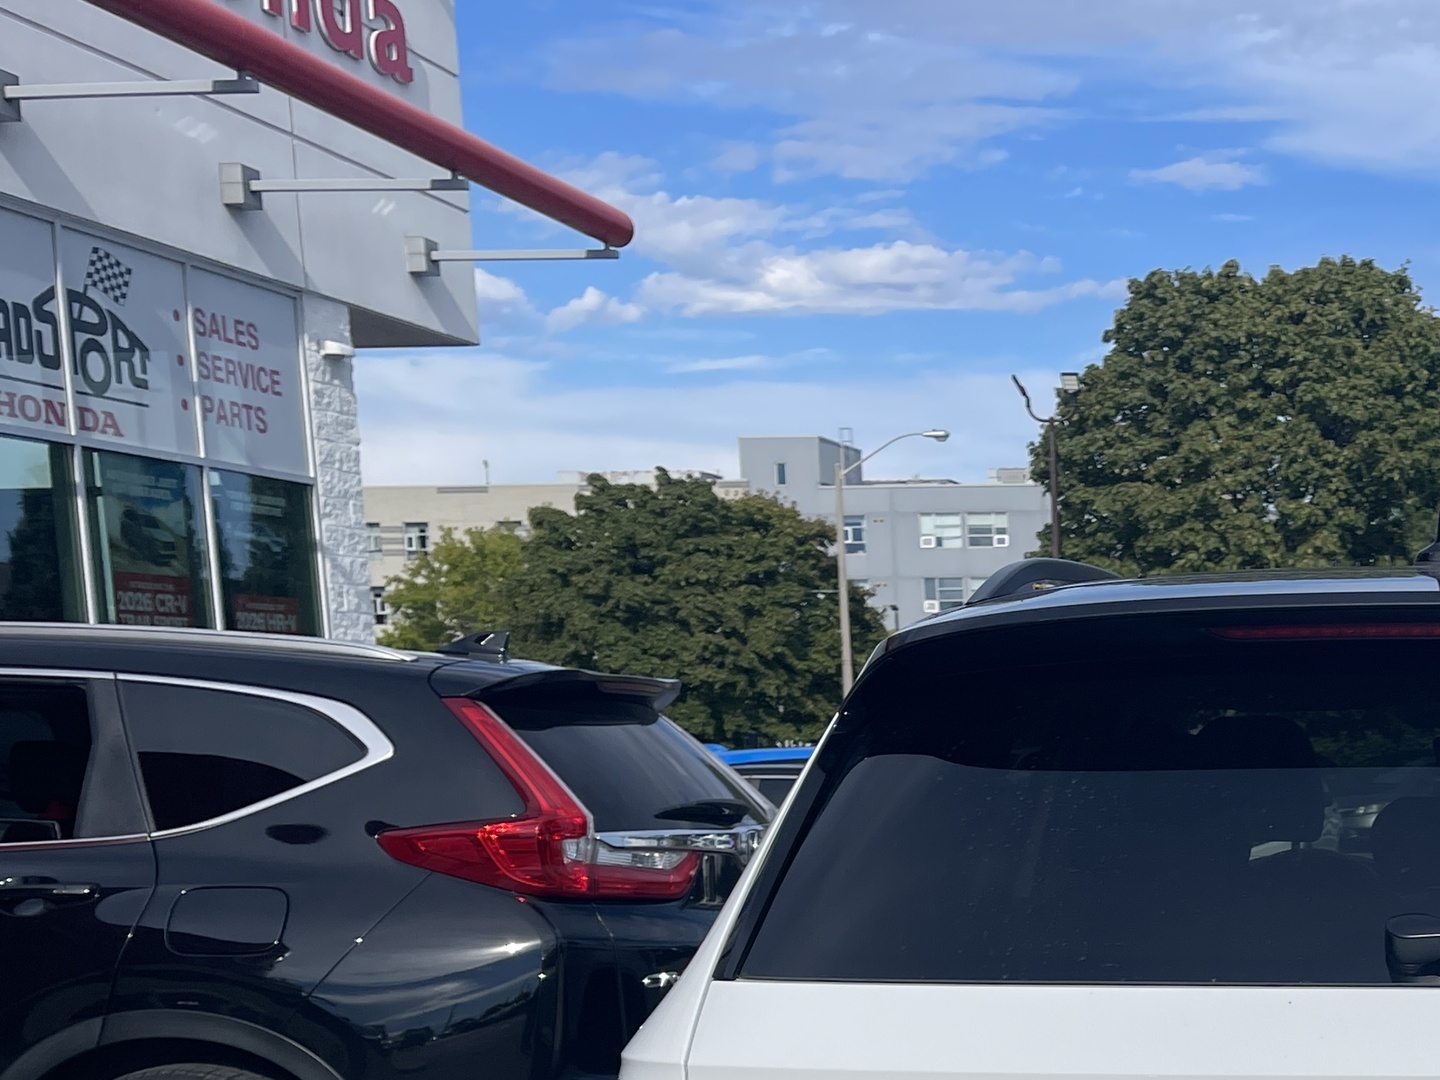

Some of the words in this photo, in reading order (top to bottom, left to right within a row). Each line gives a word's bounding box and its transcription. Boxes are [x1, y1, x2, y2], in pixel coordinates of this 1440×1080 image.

[193, 307, 259, 351] SALES
[198, 351, 283, 397] SERVICE
[0, 391, 124, 438] HONDA
[201, 394, 268, 434] PARTS
